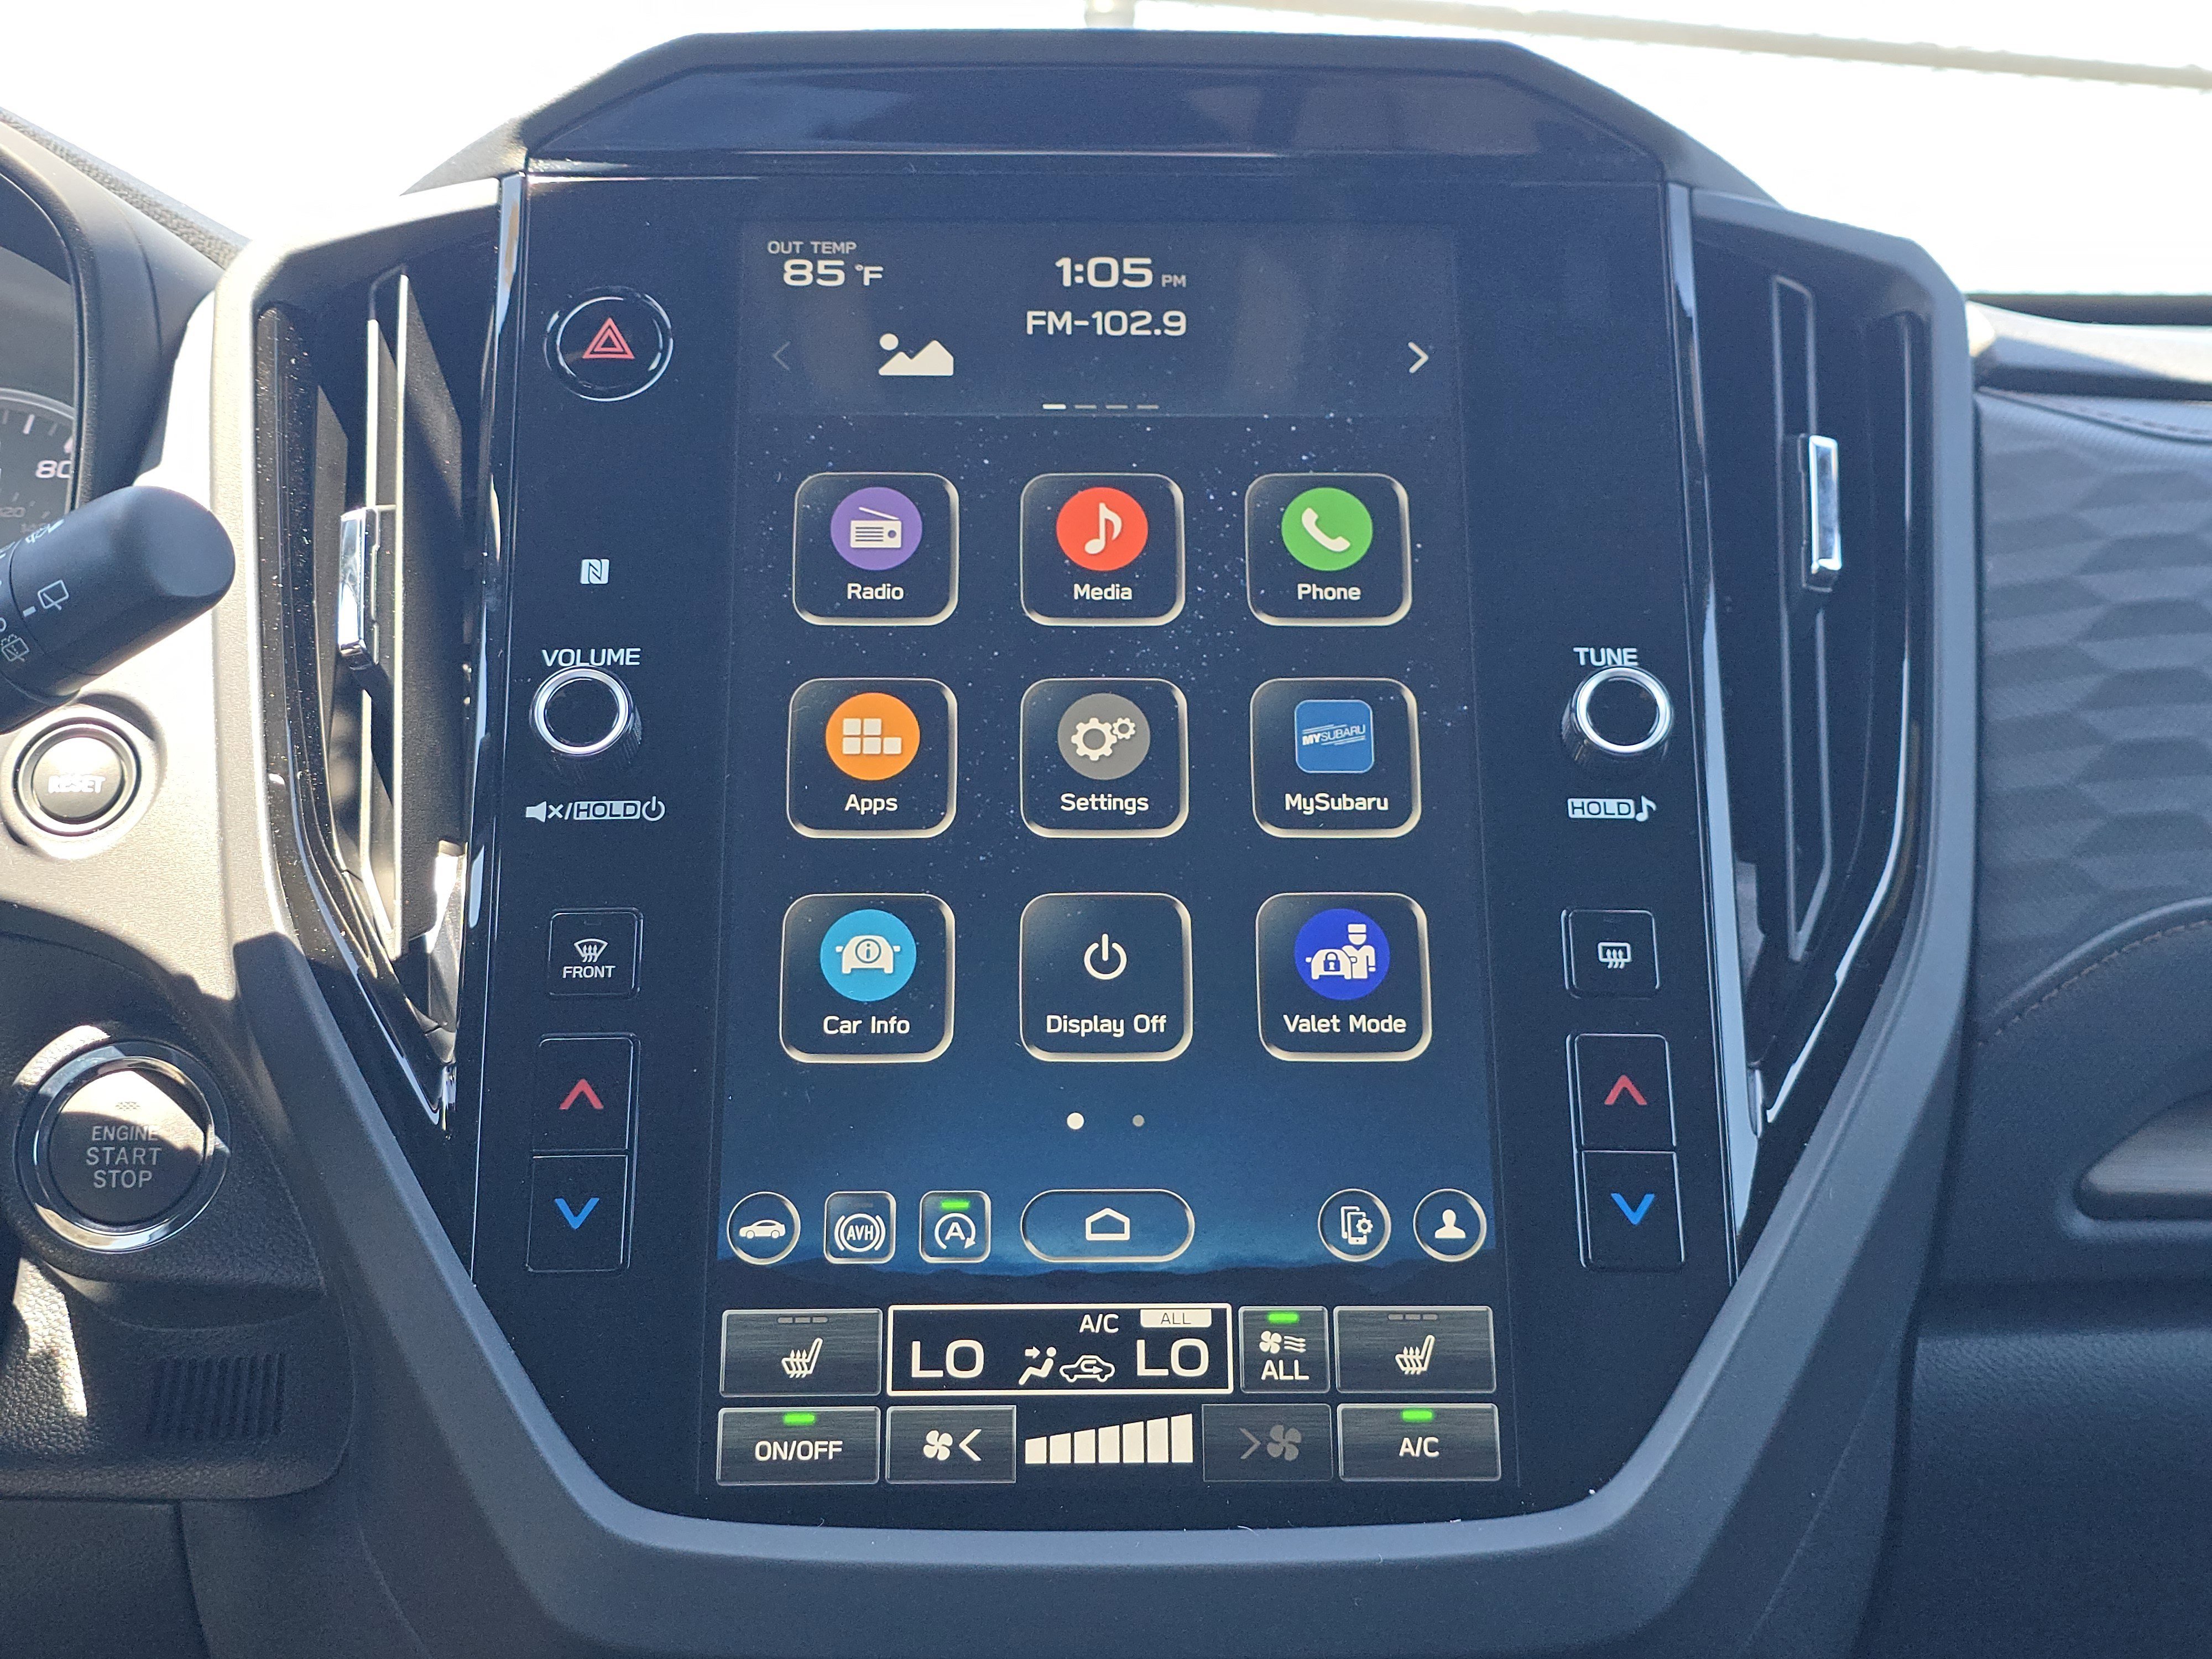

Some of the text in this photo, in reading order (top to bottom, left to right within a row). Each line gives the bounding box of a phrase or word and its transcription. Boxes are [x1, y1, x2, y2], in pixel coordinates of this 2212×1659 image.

[767, 241, 857, 254] OUT TEMP
[783, 259, 845, 286] 85
[1055, 257, 1187, 288] 1:05 PM
[1026, 310, 1186, 336] FM-102.9
[847, 583, 904, 600] Radio
[1073, 583, 1133, 601] Media
[1297, 583, 1361, 601] Phone
[542, 648, 641, 667] VOLUME
[1573, 647, 1639, 666] TUNE
[1302, 724, 1366, 745] MYSUBARU
[844, 794, 898, 815] Apps
[1060, 793, 1149, 815] Settings
[1285, 792, 1389, 815] MySubaru
[1571, 801, 1631, 816] HOLD
[562, 965, 616, 979] FRONT
[823, 1015, 910, 1035] Car Info
[1046, 1014, 1167, 1038] Display Off
[1283, 1014, 1407, 1033] Valet Mode
[86, 1146, 162, 1166] START
[93, 1169, 153, 1188] STOP
[846, 1224, 874, 1241] AVH
[1079, 1313, 1119, 1333] A/C
[1161, 1312, 1191, 1325] ALL
[911, 1339, 984, 1379] LO
[1136, 1338, 1209, 1378] LO
[1261, 1359, 1310, 1380] ALL
[755, 1440, 843, 1461] ON/OFF
[1399, 1437, 1439, 1457] A/C
